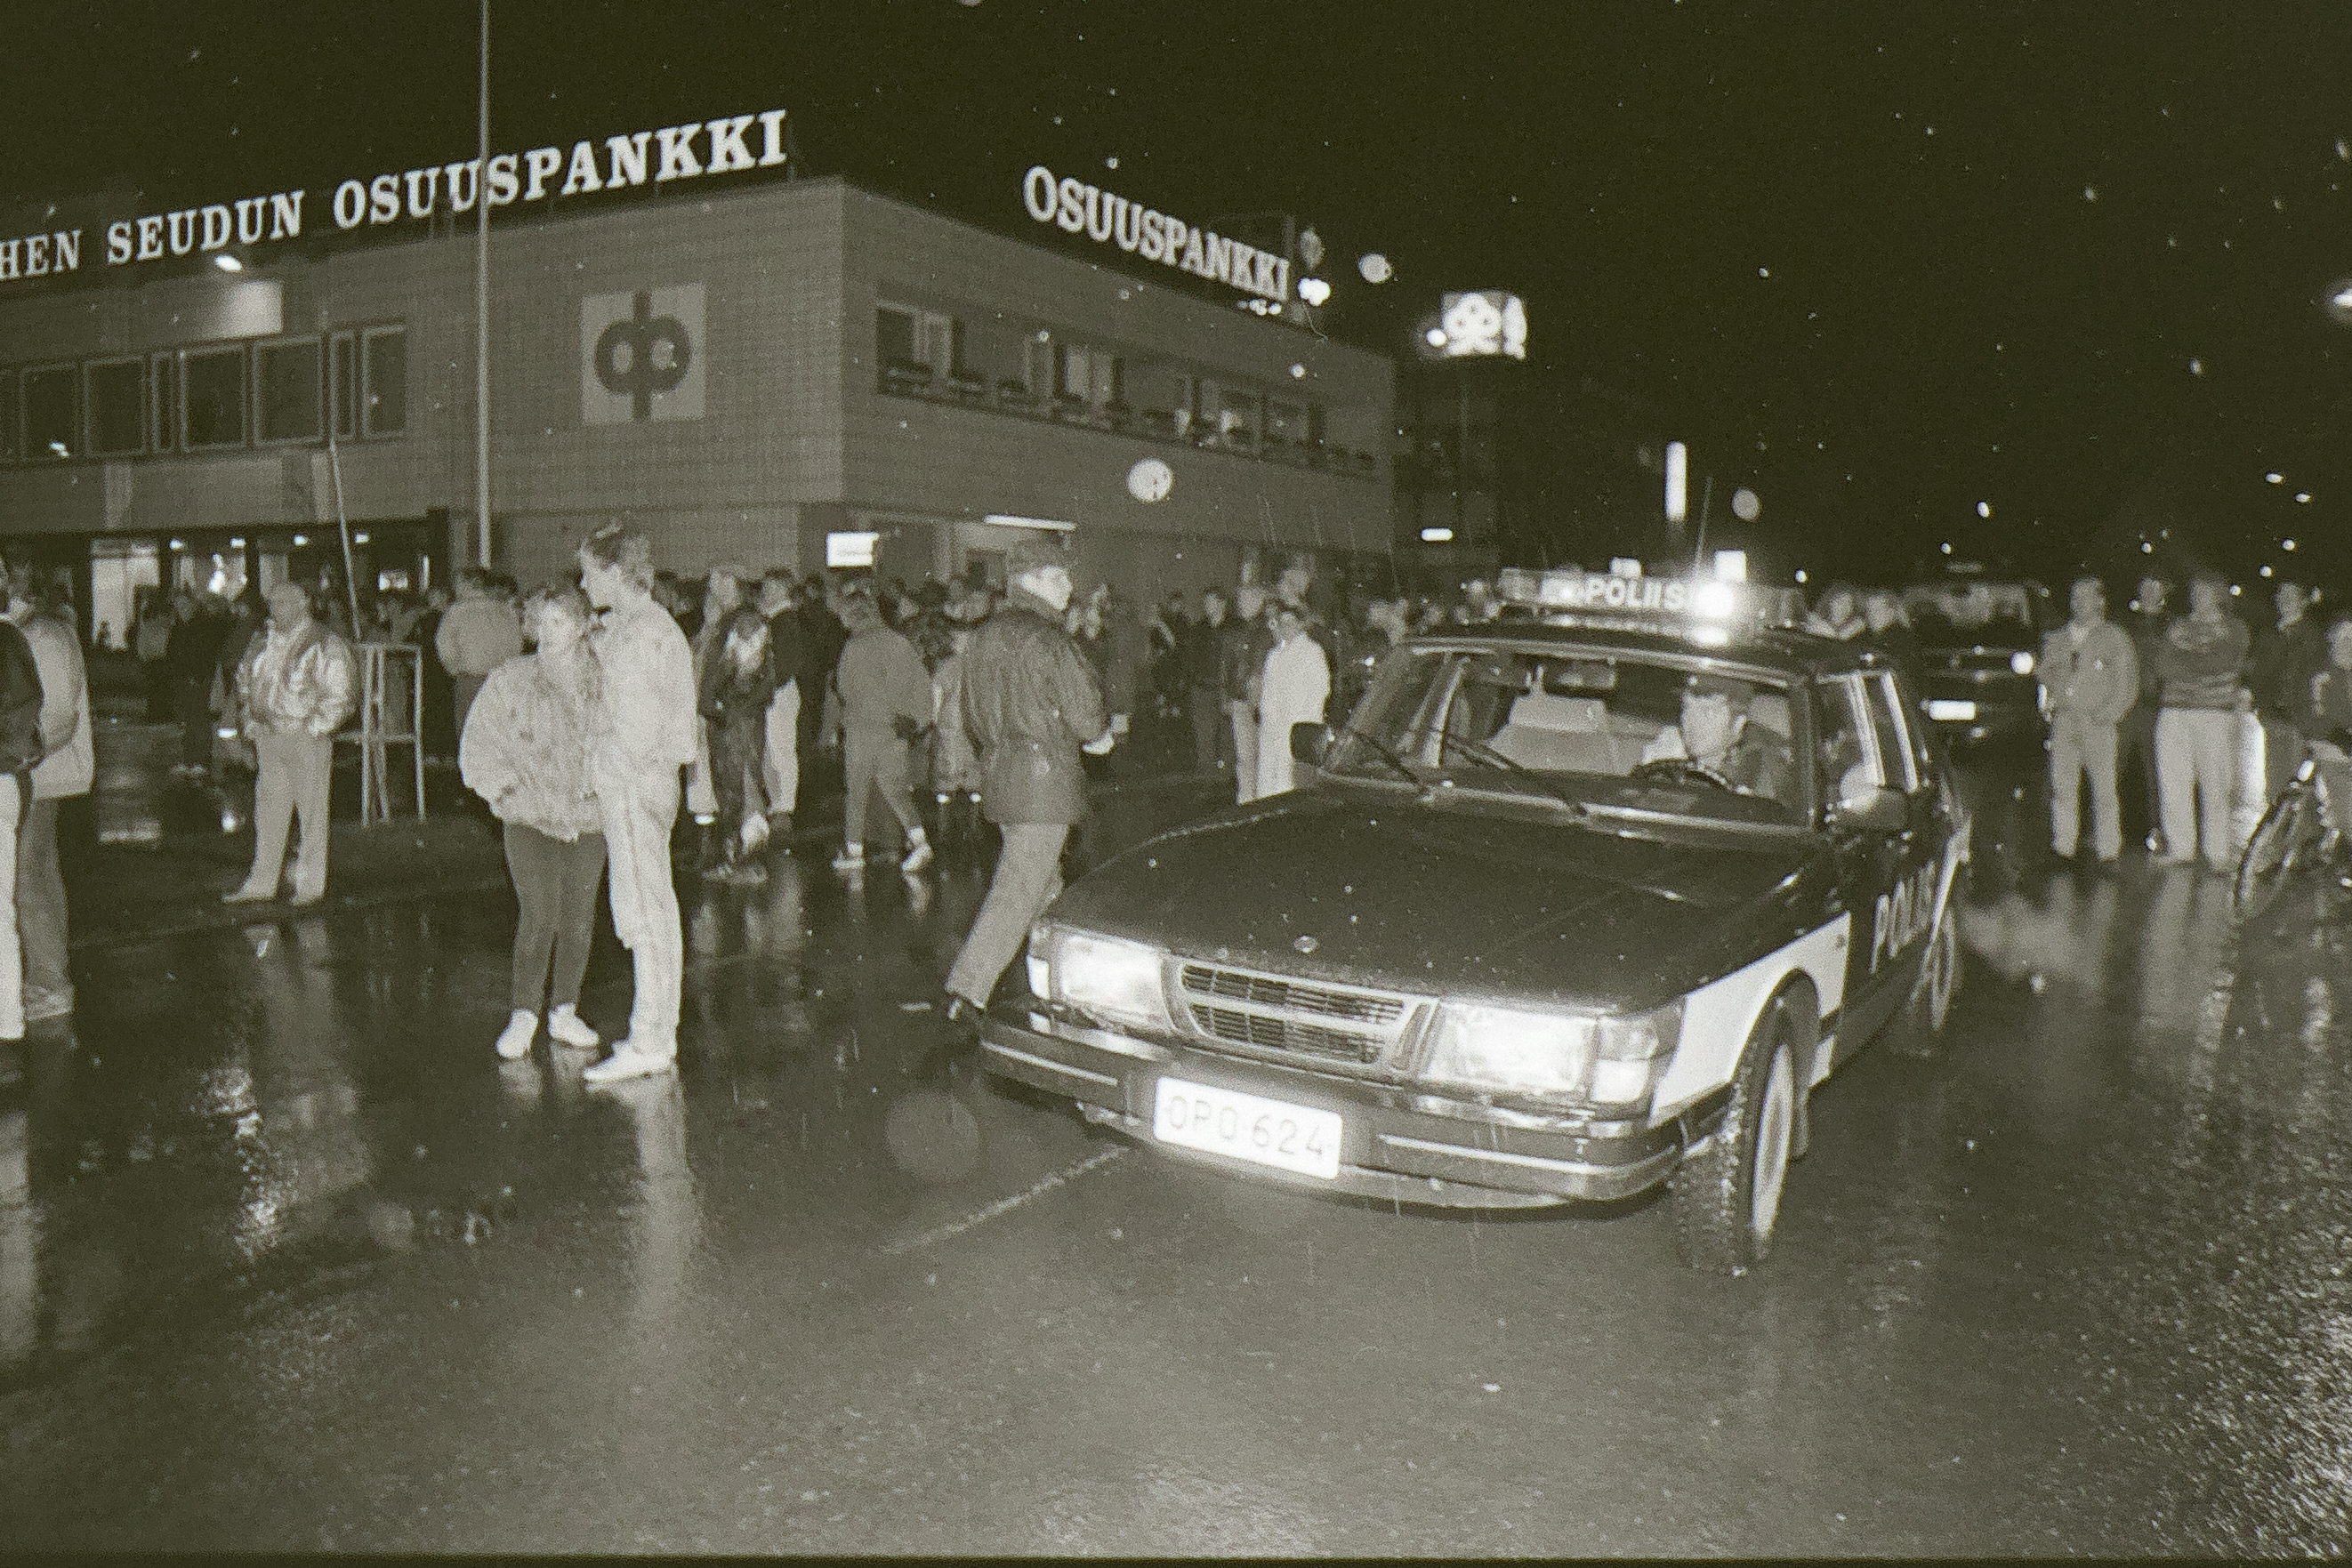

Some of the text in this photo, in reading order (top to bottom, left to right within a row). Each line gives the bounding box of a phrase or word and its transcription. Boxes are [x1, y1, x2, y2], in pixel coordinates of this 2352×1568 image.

[106, 189, 304, 264] SEUDUN
[333, 109, 787, 229] OSUUSPANKKI
[1023, 165, 1290, 301] OSUUSPANKKI
[1252, 1114, 1324, 1160] 624
